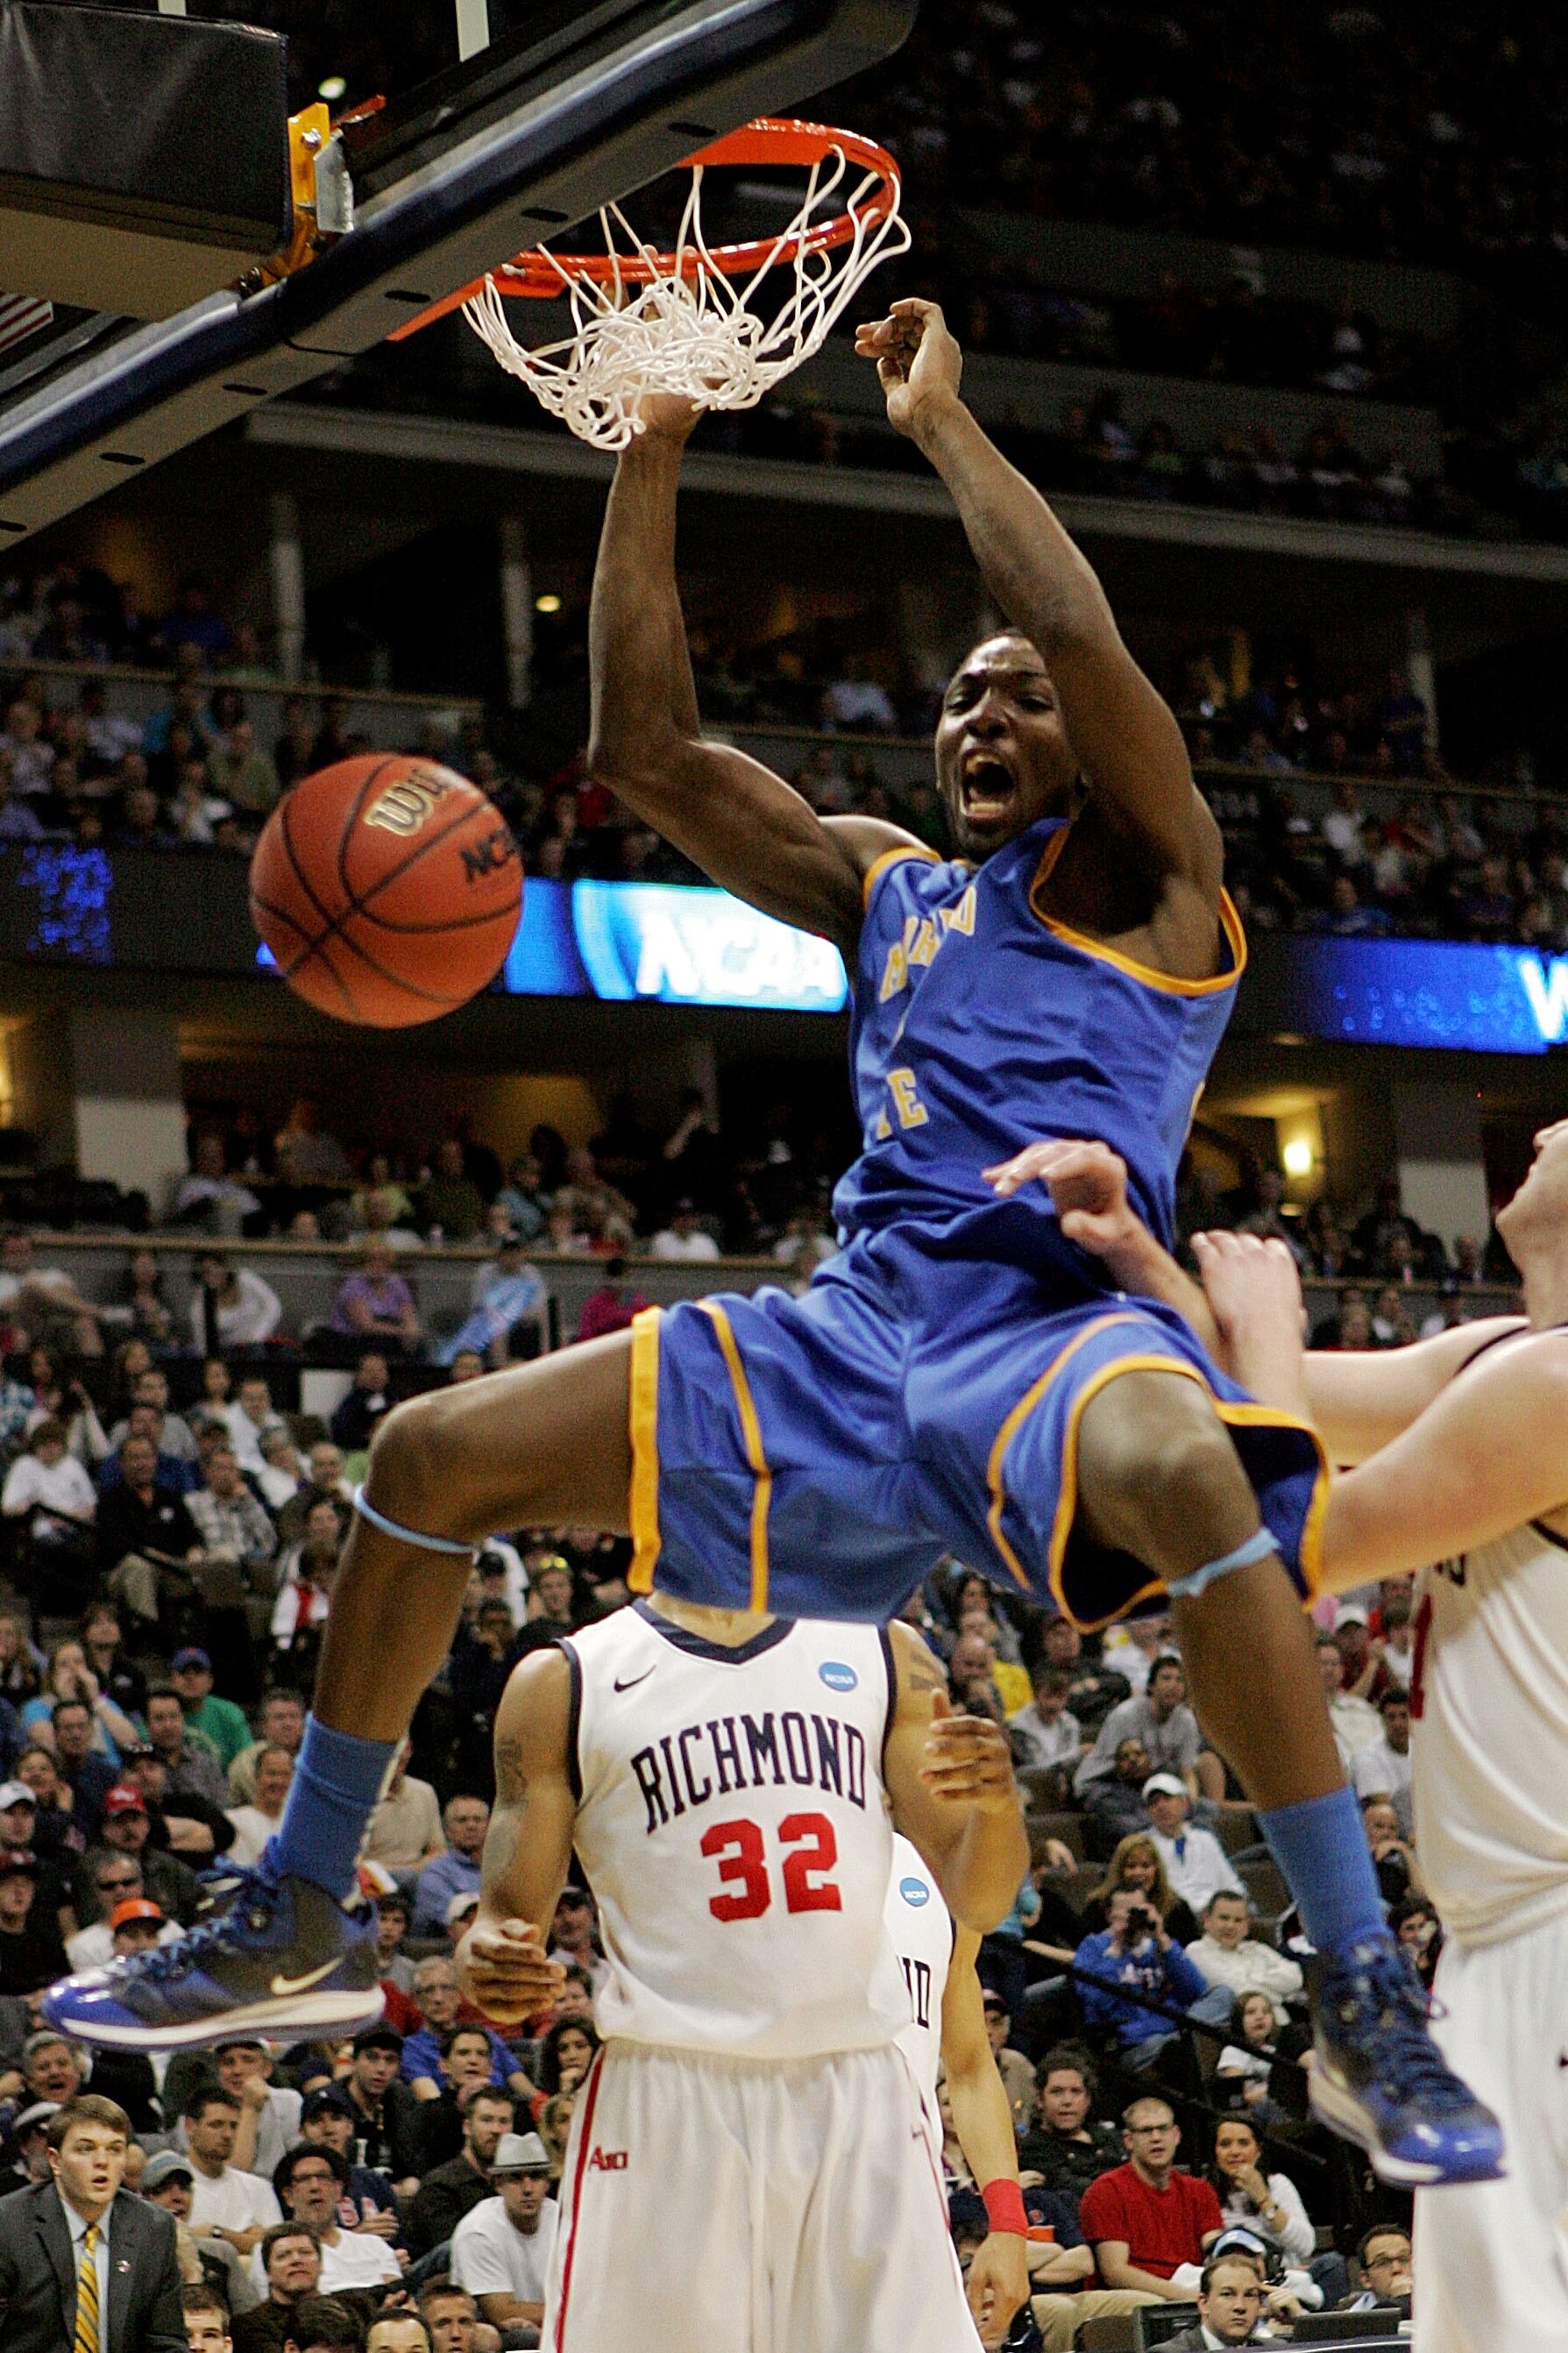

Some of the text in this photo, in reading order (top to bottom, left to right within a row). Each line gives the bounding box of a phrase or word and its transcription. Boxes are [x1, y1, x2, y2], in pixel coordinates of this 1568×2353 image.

[636, 913, 839, 997] NCAA
[630, 1712, 866, 1836] RICHMOND
[700, 1813, 842, 1923] 32
